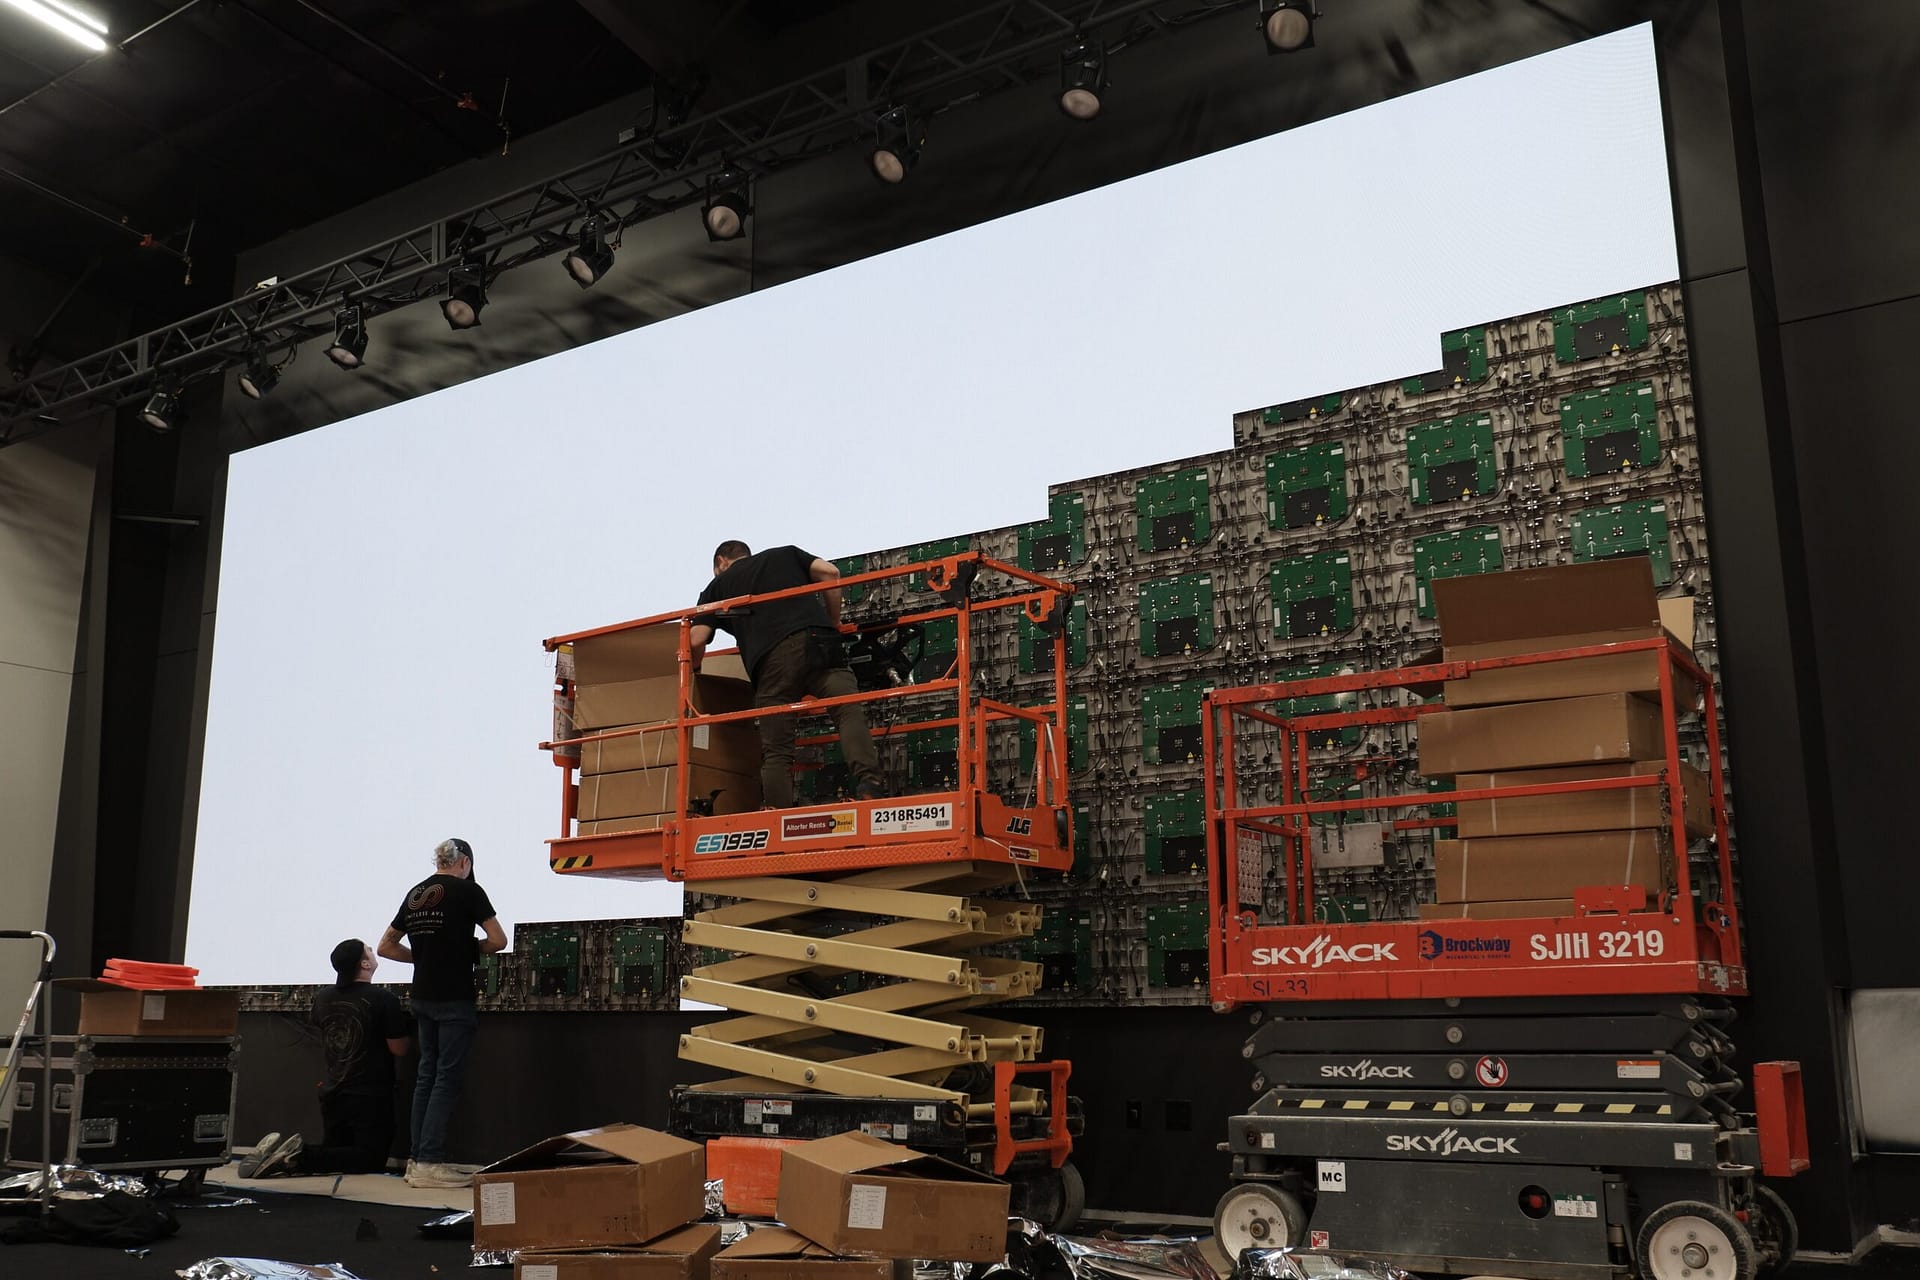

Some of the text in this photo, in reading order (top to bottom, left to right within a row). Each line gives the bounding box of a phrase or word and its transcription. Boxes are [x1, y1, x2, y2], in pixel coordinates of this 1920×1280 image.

[874, 806, 945, 823] 2318R5491
[808, 822, 826, 830] Rents
[1006, 816, 1032, 836] JLG
[696, 831, 769, 854] ES1932
[1251, 934, 1400, 968] SKYJACK
[1445, 937, 1511, 952] Brockway
[1598, 929, 1664, 958] 3219
[1320, 1059, 1414, 1080] SKYJACK
[1386, 1127, 1521, 1156] SKYJACK
[1322, 1172, 1342, 1182] MC
